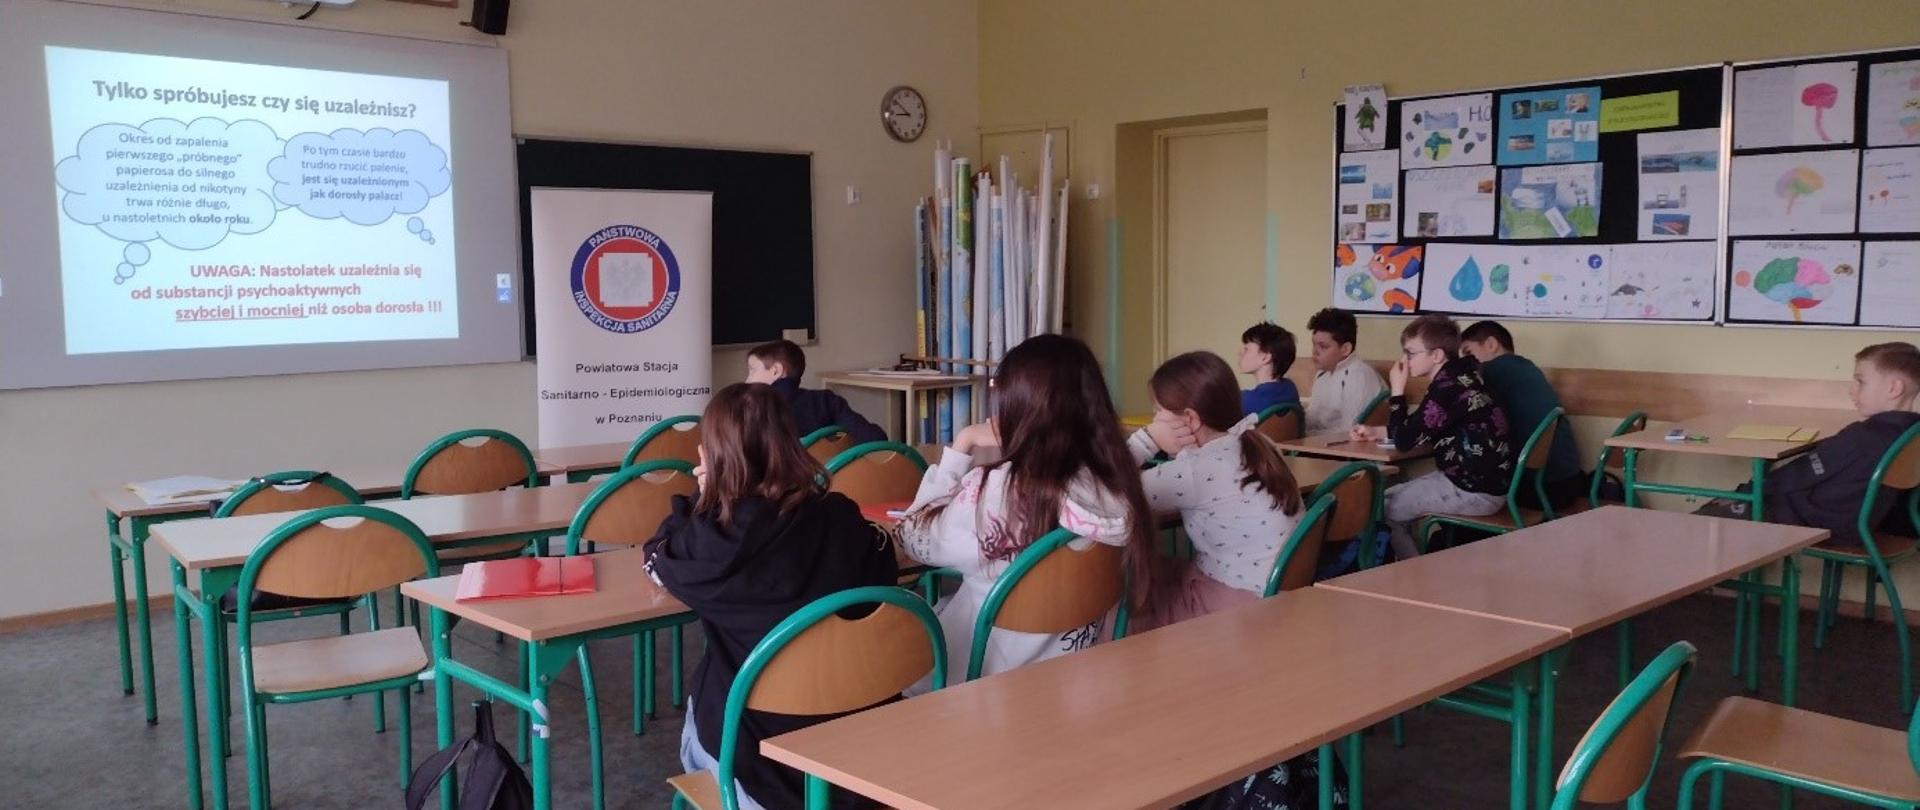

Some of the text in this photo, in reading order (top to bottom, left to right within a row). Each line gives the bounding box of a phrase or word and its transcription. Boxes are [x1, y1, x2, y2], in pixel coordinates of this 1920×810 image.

[92, 80, 417, 118] Tylko spróbujesz czy się uzależnisz?
[118, 132, 229, 148] Okres od zapalenia
[105, 148, 174, 163] pierwszego
[303, 145, 406, 159] Po tym czasie bardzo
[115, 165, 236, 180] papierosa do silnego
[301, 160, 408, 175] trudno rzucić palenie,
[105, 180, 247, 196] uzależnienia od nikotyny
[301, 174, 409, 188] jest się uzależnionym
[310, 189, 403, 201] jak dorosły palacz!
[126, 197, 231, 210] trwa różnie długo,
[102, 213, 253, 224] u nastoletnich około roku.
[190, 264, 422, 278] UWAGA: Nastolatek uzależnia się
[131, 283, 361, 299] od substancji psychoaktywnych
[175, 300, 442, 320] szybciej i mocniej niż osoba dorosła !!!
[574, 290, 678, 333] INSPEKCJA SANITARNA
[575, 361, 679, 374] Powiatowa Stacja
[541, 389, 600, 400] Sanitarno
[610, 386, 710, 399] Epidemiologiczna
[595, 412, 663, 424] w Poznaniu
